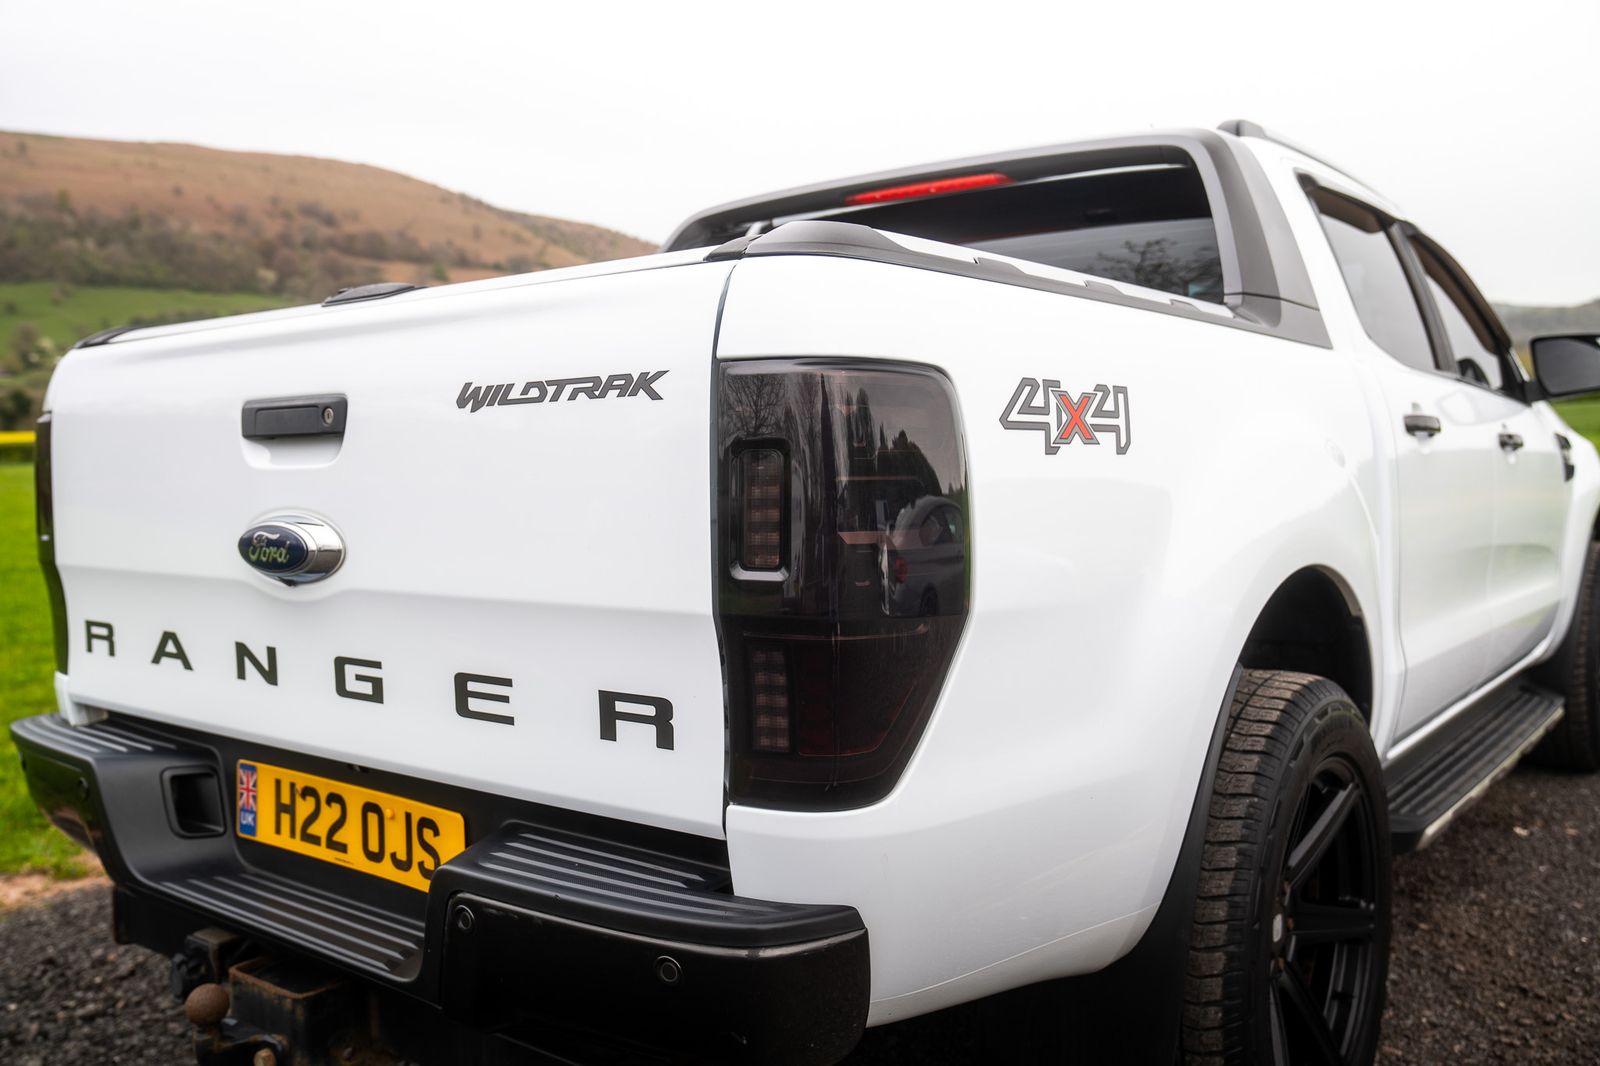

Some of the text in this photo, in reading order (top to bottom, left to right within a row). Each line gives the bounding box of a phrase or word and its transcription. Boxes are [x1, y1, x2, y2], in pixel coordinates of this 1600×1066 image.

[456, 369, 670, 413] WILDTRAK
[248, 531, 290, 564] Ford
[86, 619, 675, 751] RANGER
[240, 813, 255, 826] UK
[274, 778, 348, 854] H22
